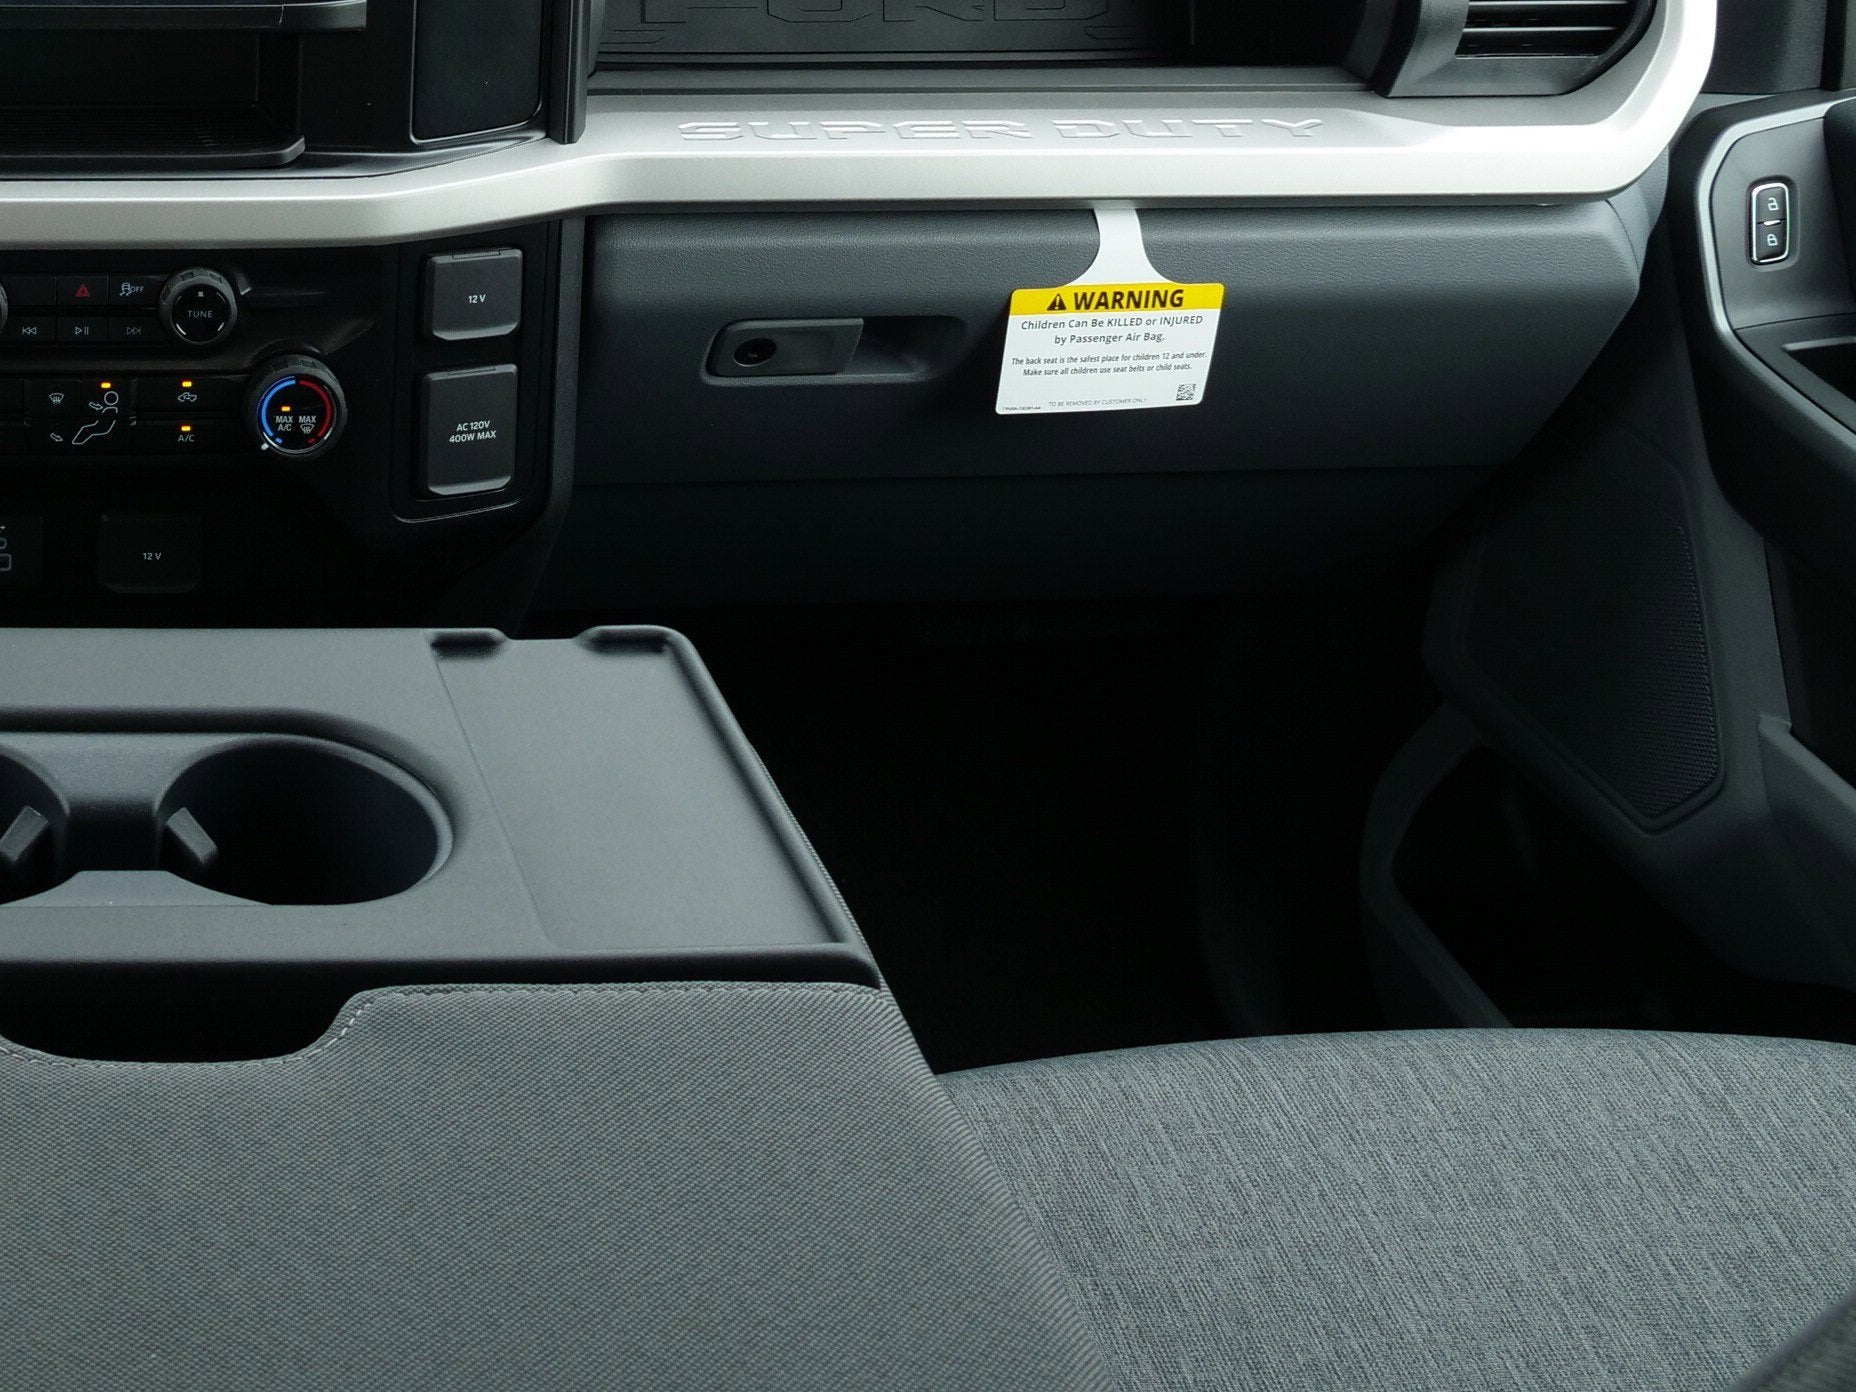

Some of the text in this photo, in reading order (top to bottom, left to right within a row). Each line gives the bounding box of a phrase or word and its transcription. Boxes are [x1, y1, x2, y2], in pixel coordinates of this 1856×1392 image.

[677, 118, 1324, 141] SUPER DUTY
[130, 284, 145, 293] OFF
[468, 294, 486, 304] 12 V
[1073, 289, 1185, 310] WARNING
[187, 309, 213, 318] TUNE
[1021, 315, 1204, 330] Children Can Be KILLED or INJURED
[1054, 332, 1166, 346] by Passenger Air Bag.
[1011, 357, 1025, 365] The
[1026, 357, 1042, 365] back
[1043, 357, 1058, 365] seat
[1066, 356, 1078, 364] the
[1079, 355, 1100, 363] safest
[1101, 354, 1120, 364] place
[1121, 353, 1131, 362] for
[1132, 353, 1160, 362] children
[1161, 352, 1170, 360] 12
[1171, 352, 1184, 360] and
[1185, 351, 1208, 359] under.
[1023, 368, 1042, 376] Make
[1059, 367, 1069, 375] all
[1070, 366, 1098, 375] children
[1128, 365, 1145, 373] belts
[1155, 364, 1171, 372] child
[1173, 363, 1192, 371] seats.
[275, 415, 294, 423] MAX
[298, 415, 317, 423] MAX
[277, 424, 293, 432] A/C
[455, 420, 491, 432] AC 120V
[177, 434, 195, 443] A/C
[448, 430, 497, 444] 400W MAX
[142, 552, 153, 561] 12
